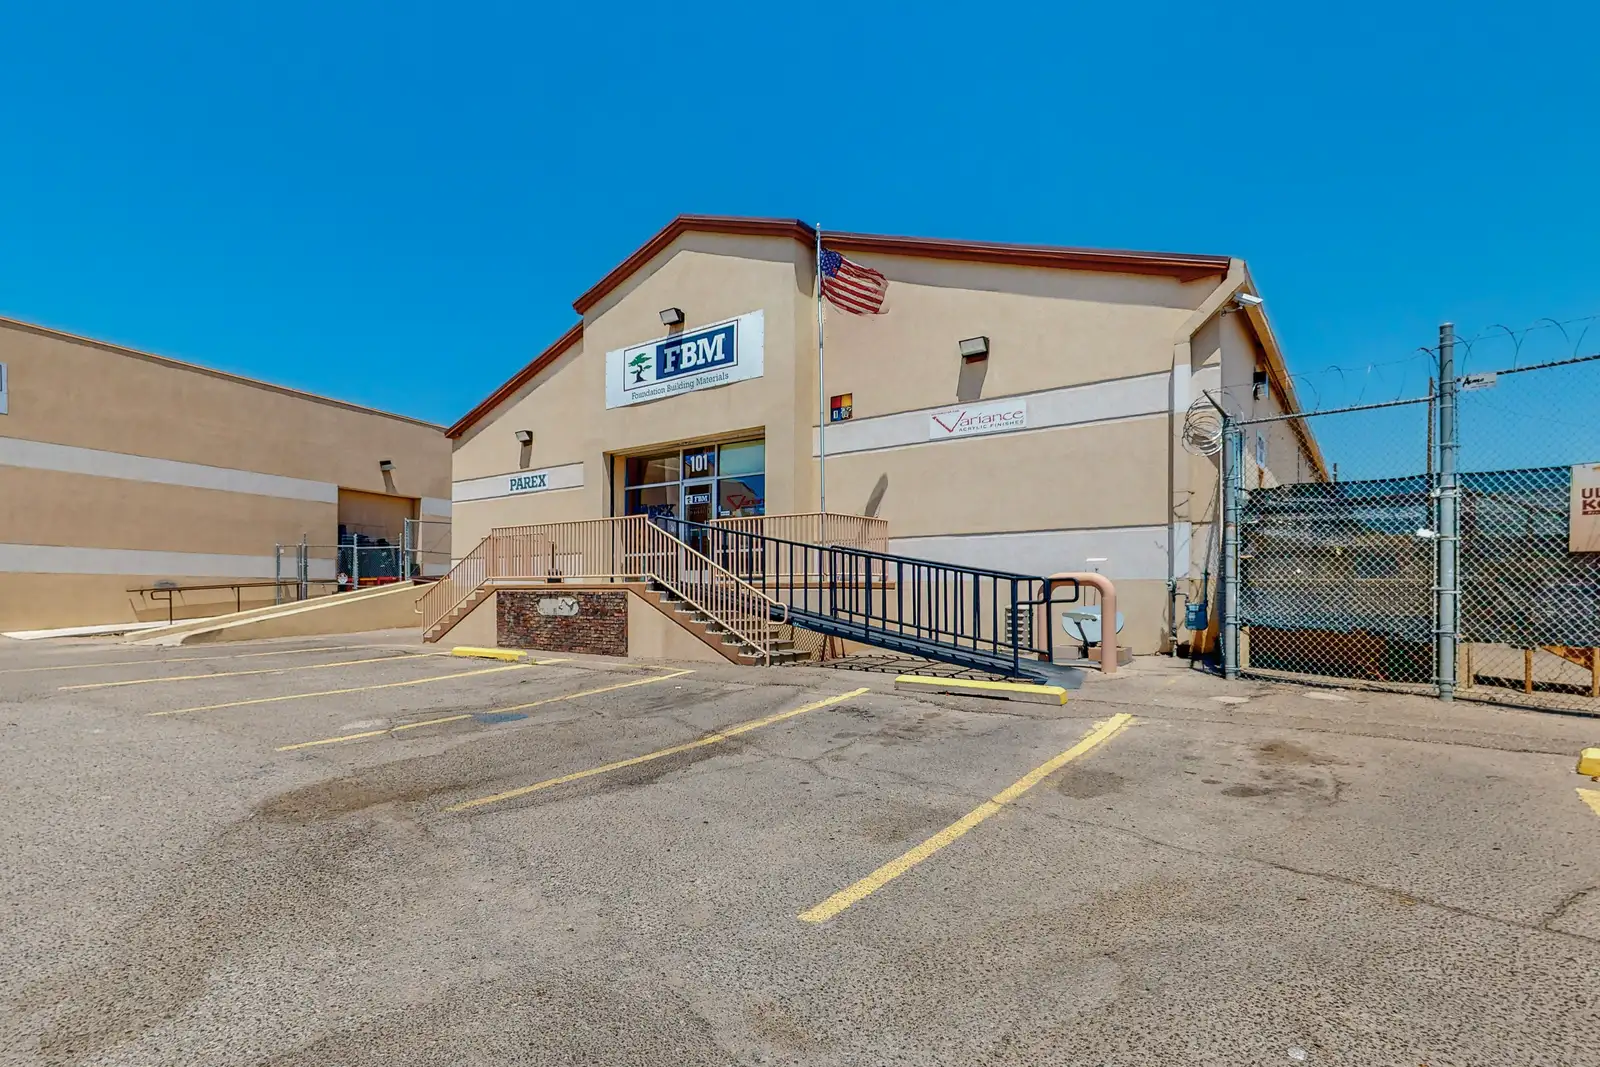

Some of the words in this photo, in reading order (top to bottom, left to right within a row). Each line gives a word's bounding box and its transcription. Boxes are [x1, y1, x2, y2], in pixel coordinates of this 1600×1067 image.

[663, 333, 727, 374] FBM
[631, 387, 666, 400] Foundation
[666, 379, 695, 392] Building
[695, 372, 729, 386] Materials
[932, 410, 1024, 433] Variance
[989, 420, 1024, 429] FINISHES
[690, 454, 708, 472] 101
[510, 474, 547, 491] PAREX
